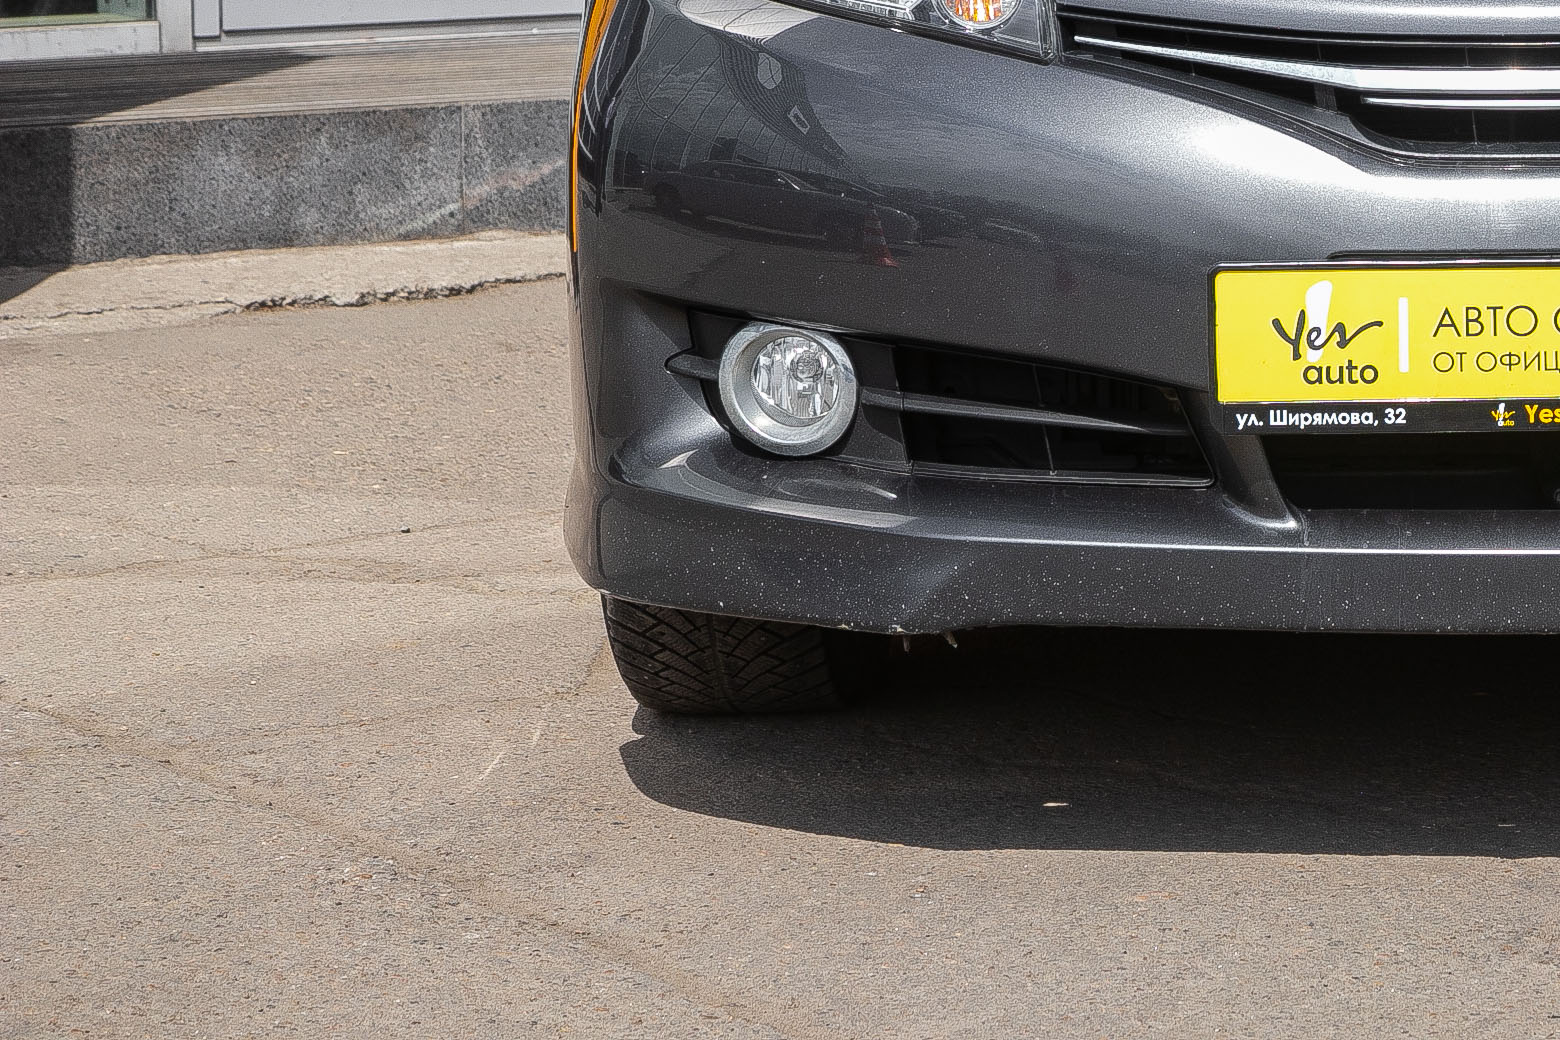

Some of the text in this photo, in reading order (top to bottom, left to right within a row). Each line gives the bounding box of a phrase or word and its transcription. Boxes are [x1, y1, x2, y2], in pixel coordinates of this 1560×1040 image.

[1432, 304, 1539, 338] АВТО
[1271, 308, 1384, 361] Yes
[1302, 359, 1379, 385] auto
[1432, 350, 1468, 373] ОТ
[1235, 407, 1408, 430] ул. Ширямова, 32
